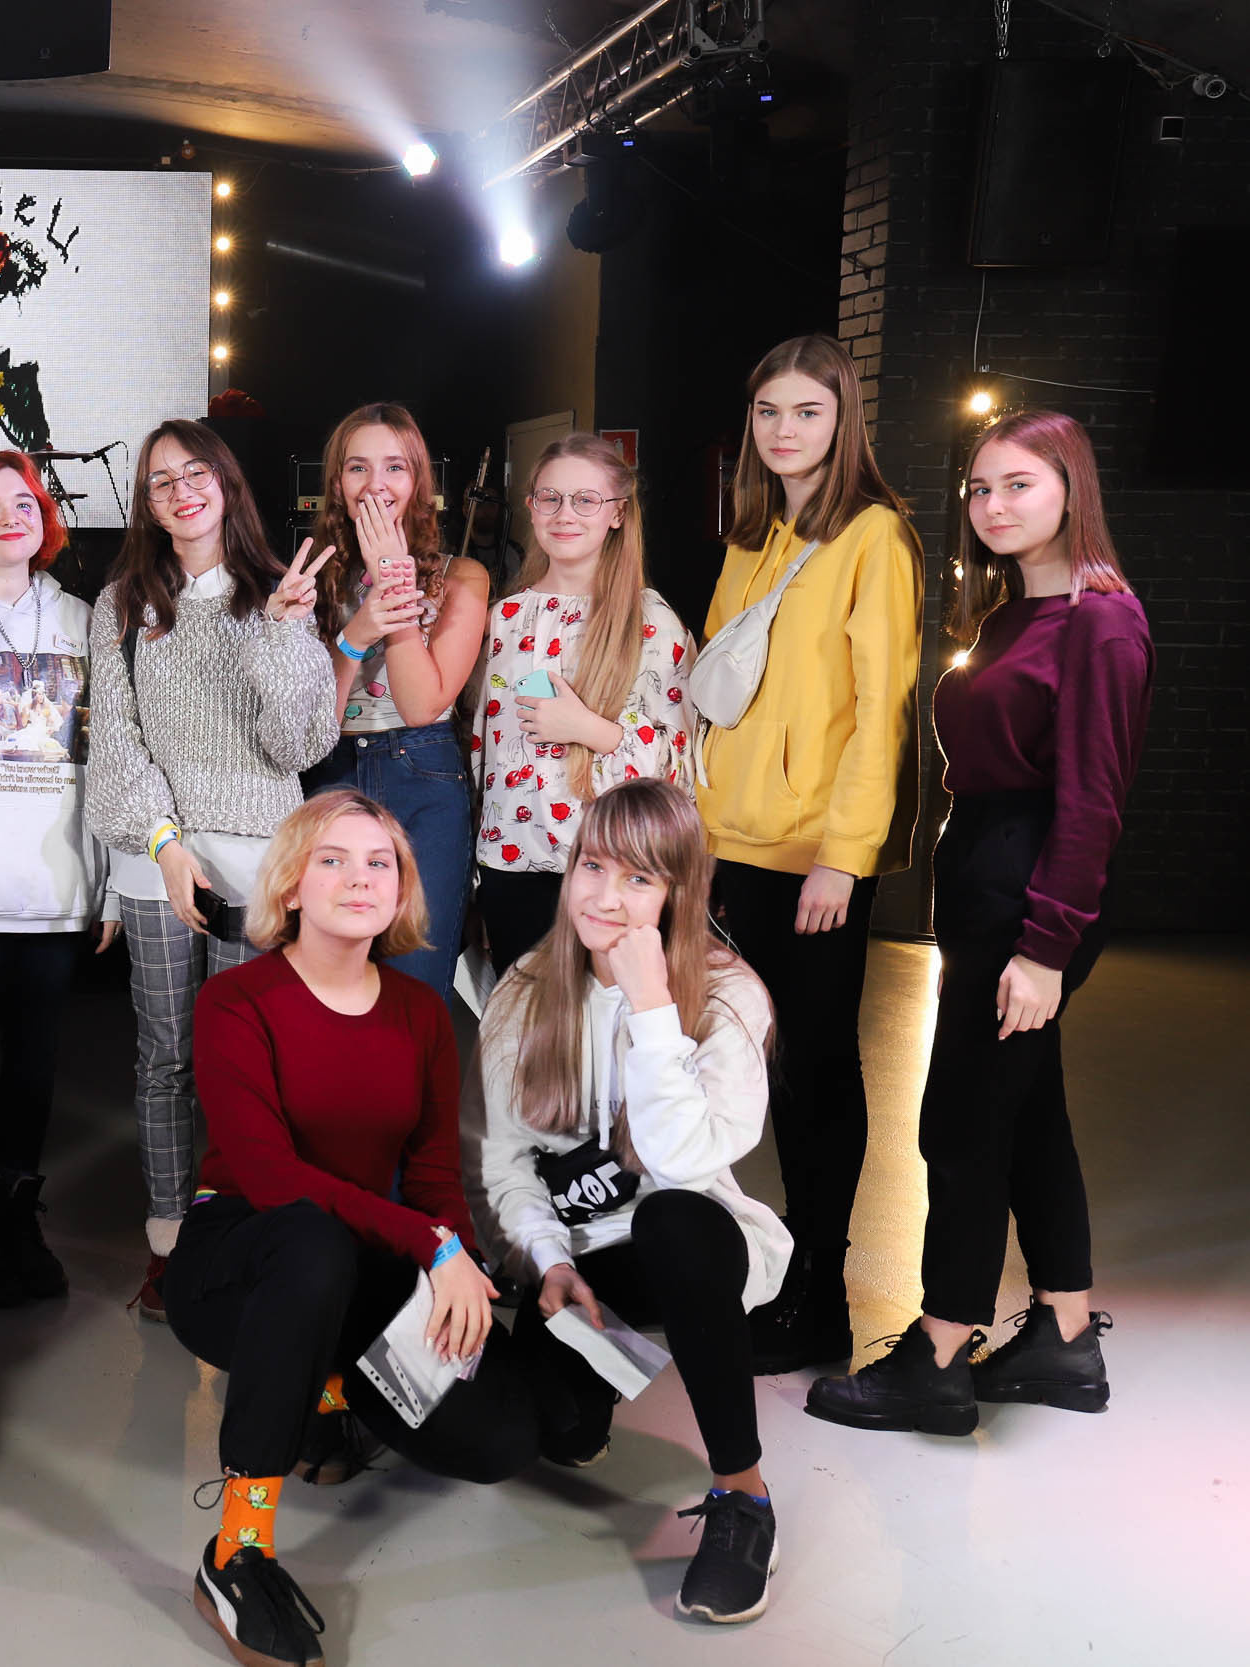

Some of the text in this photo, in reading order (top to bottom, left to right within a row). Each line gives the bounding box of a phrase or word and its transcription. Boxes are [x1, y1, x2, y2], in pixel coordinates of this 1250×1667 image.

[16, 764, 36, 773] know
[16, 774, 23, 783] be
[24, 774, 54, 784] allowed
[55, 776, 62, 785] to
